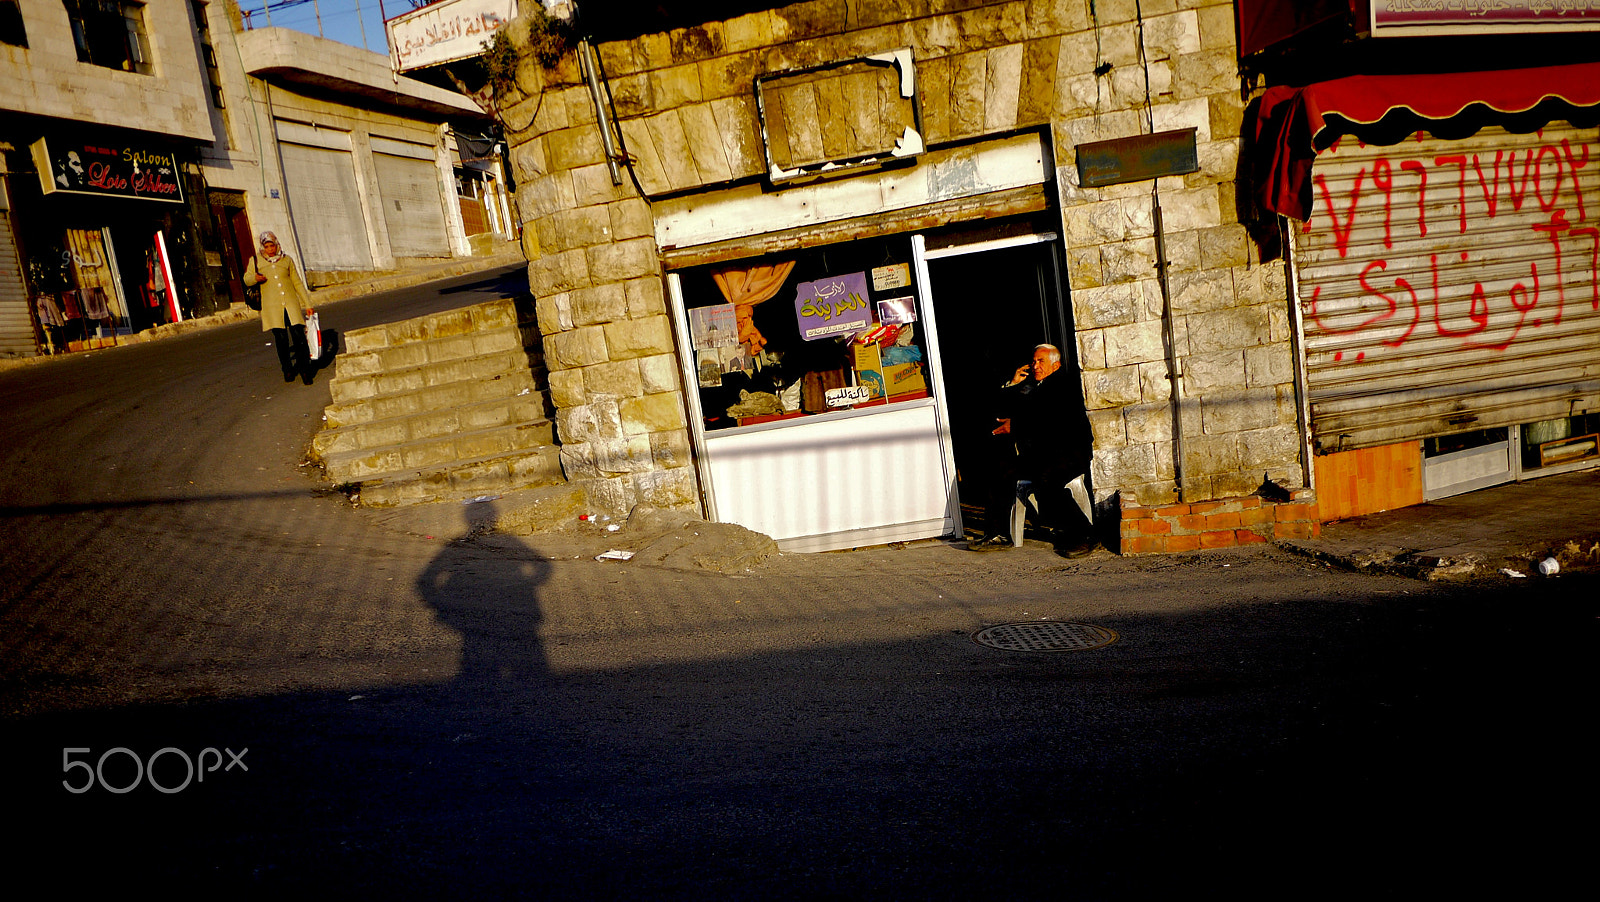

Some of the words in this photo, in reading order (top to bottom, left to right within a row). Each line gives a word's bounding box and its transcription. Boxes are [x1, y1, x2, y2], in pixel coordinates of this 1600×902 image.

[122, 147, 171, 167] Saloon
[800, 292, 867, 322] الحديثة
[826, 388, 848, 407] للبيع
